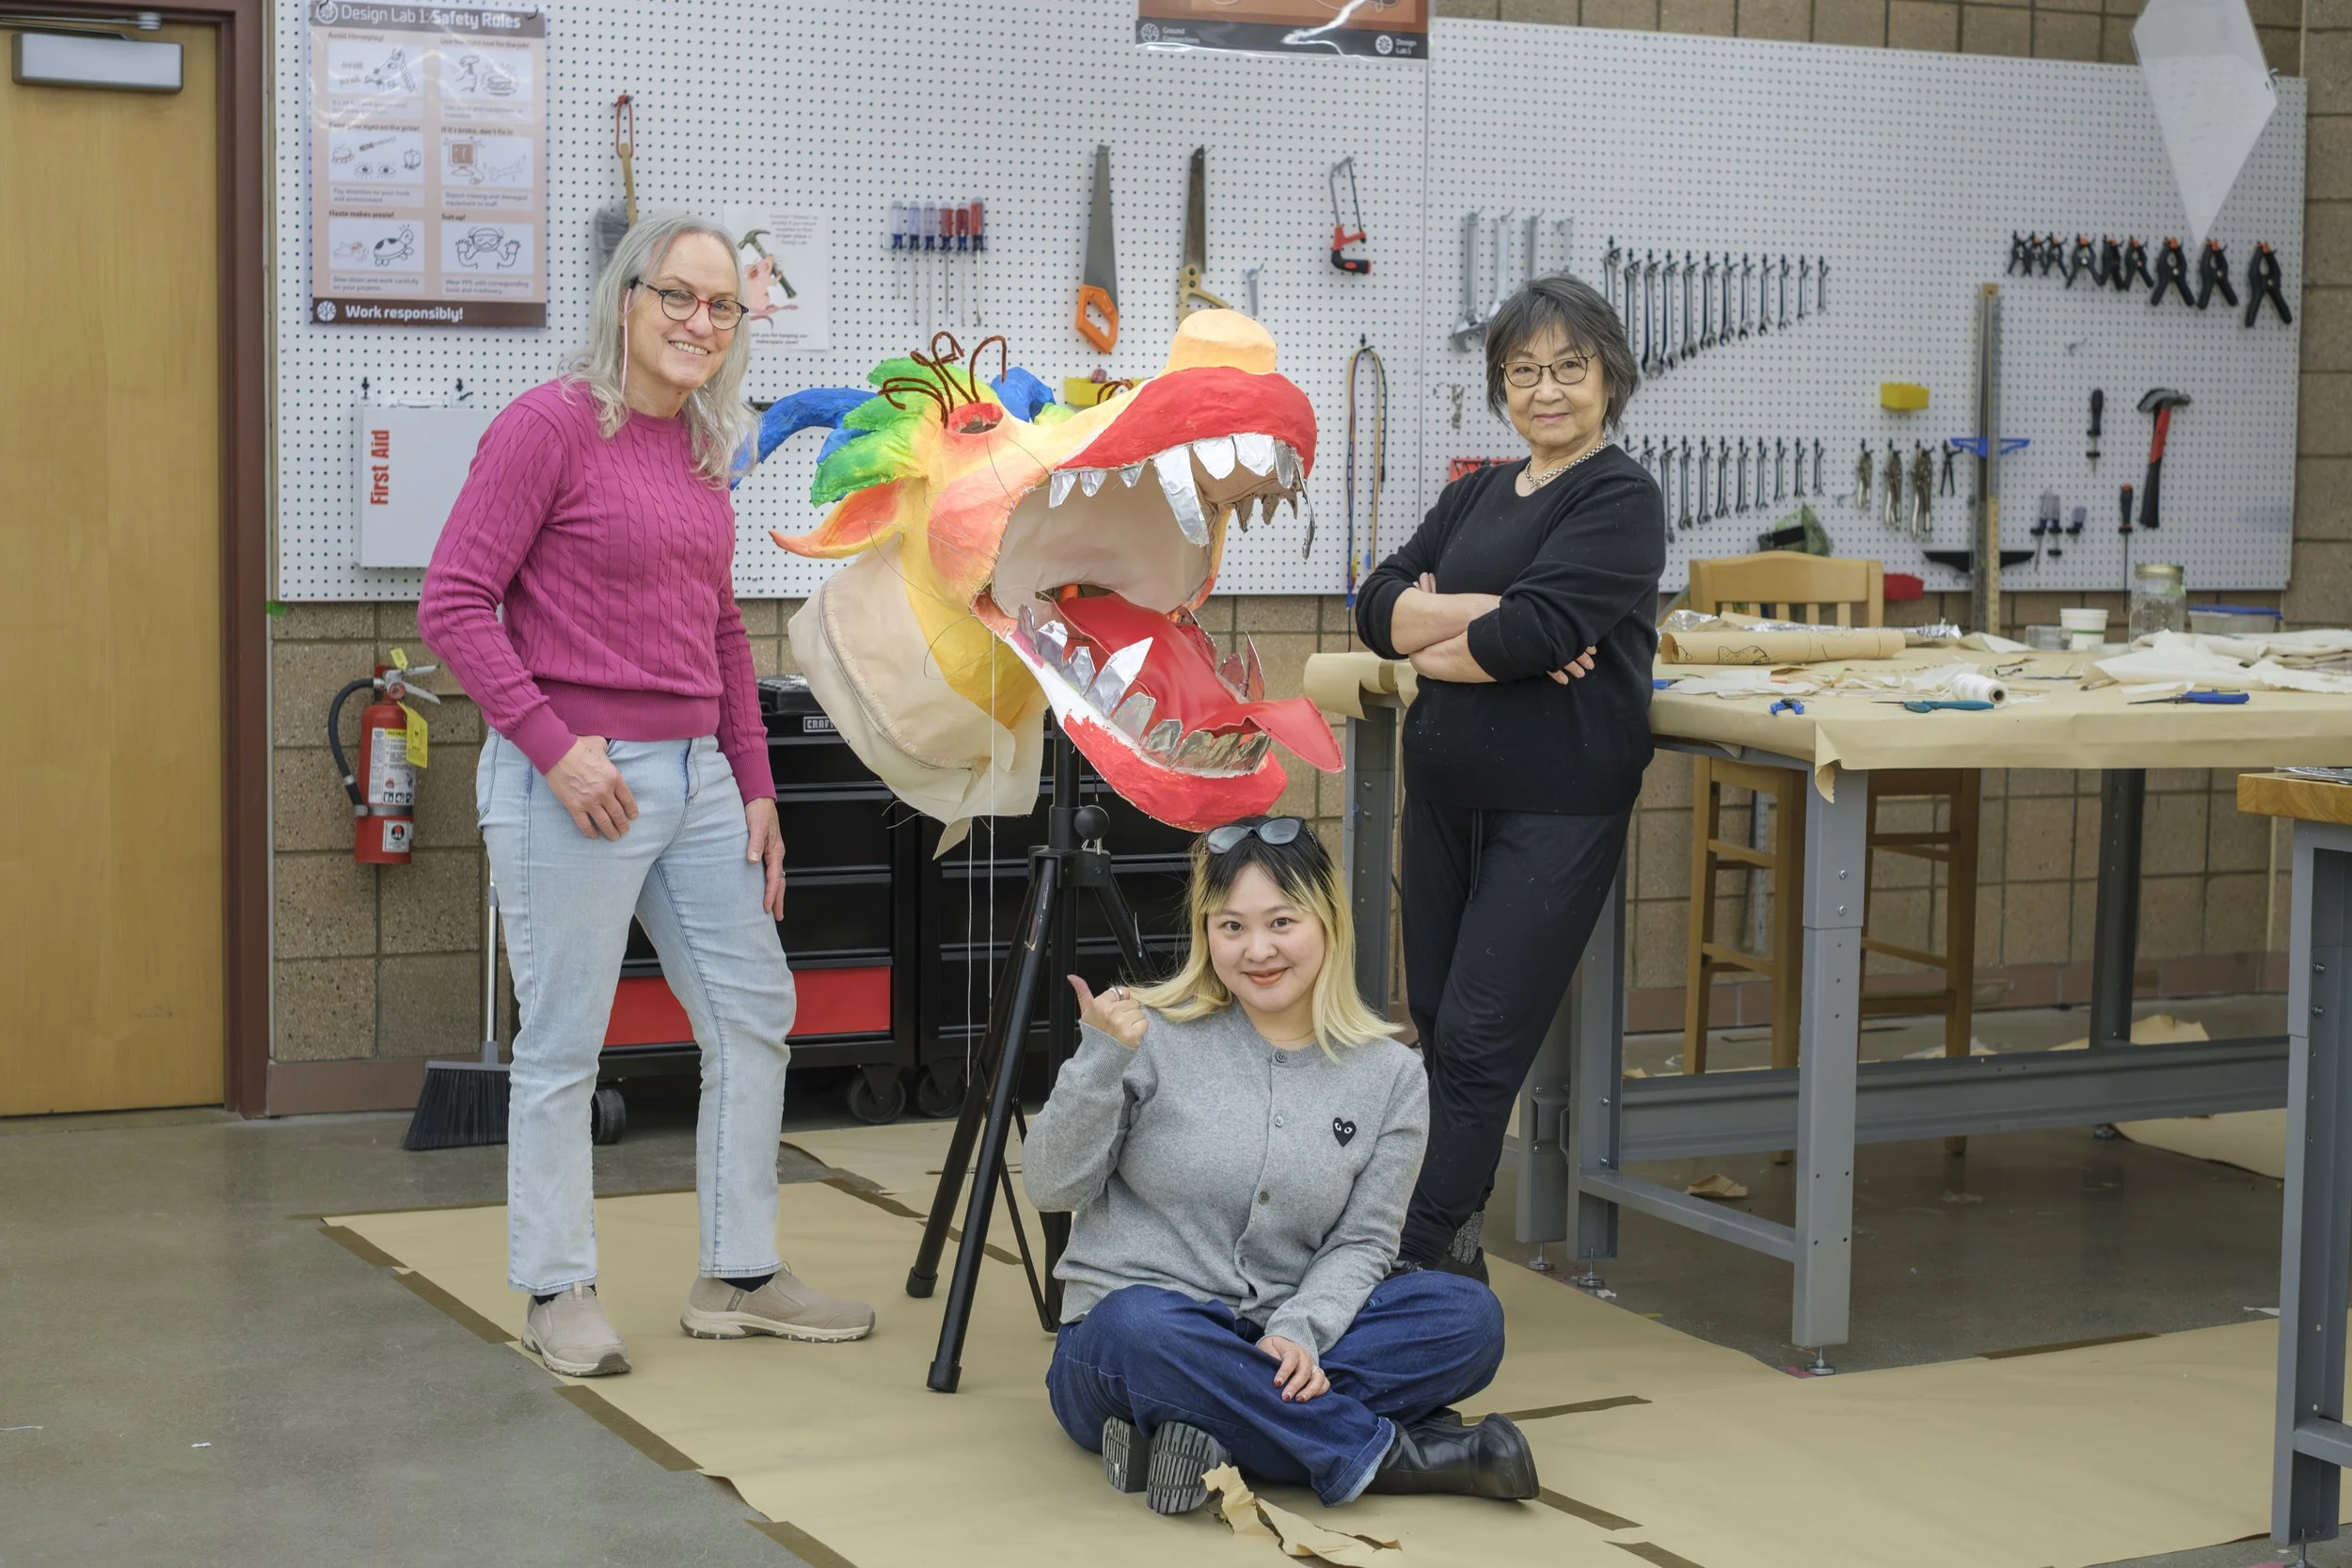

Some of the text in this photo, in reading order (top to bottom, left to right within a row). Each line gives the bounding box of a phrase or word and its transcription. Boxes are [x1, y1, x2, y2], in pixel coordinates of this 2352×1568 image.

[342, 4, 388, 24] Design
[390, 7, 416, 24] Lab
[431, 9, 478, 30] Safety
[481, 11, 521, 29] Rules
[349, 210, 372, 218] makes
[344, 304, 464, 324] Work responsibly!
[370, 429, 389, 505] First Aid
